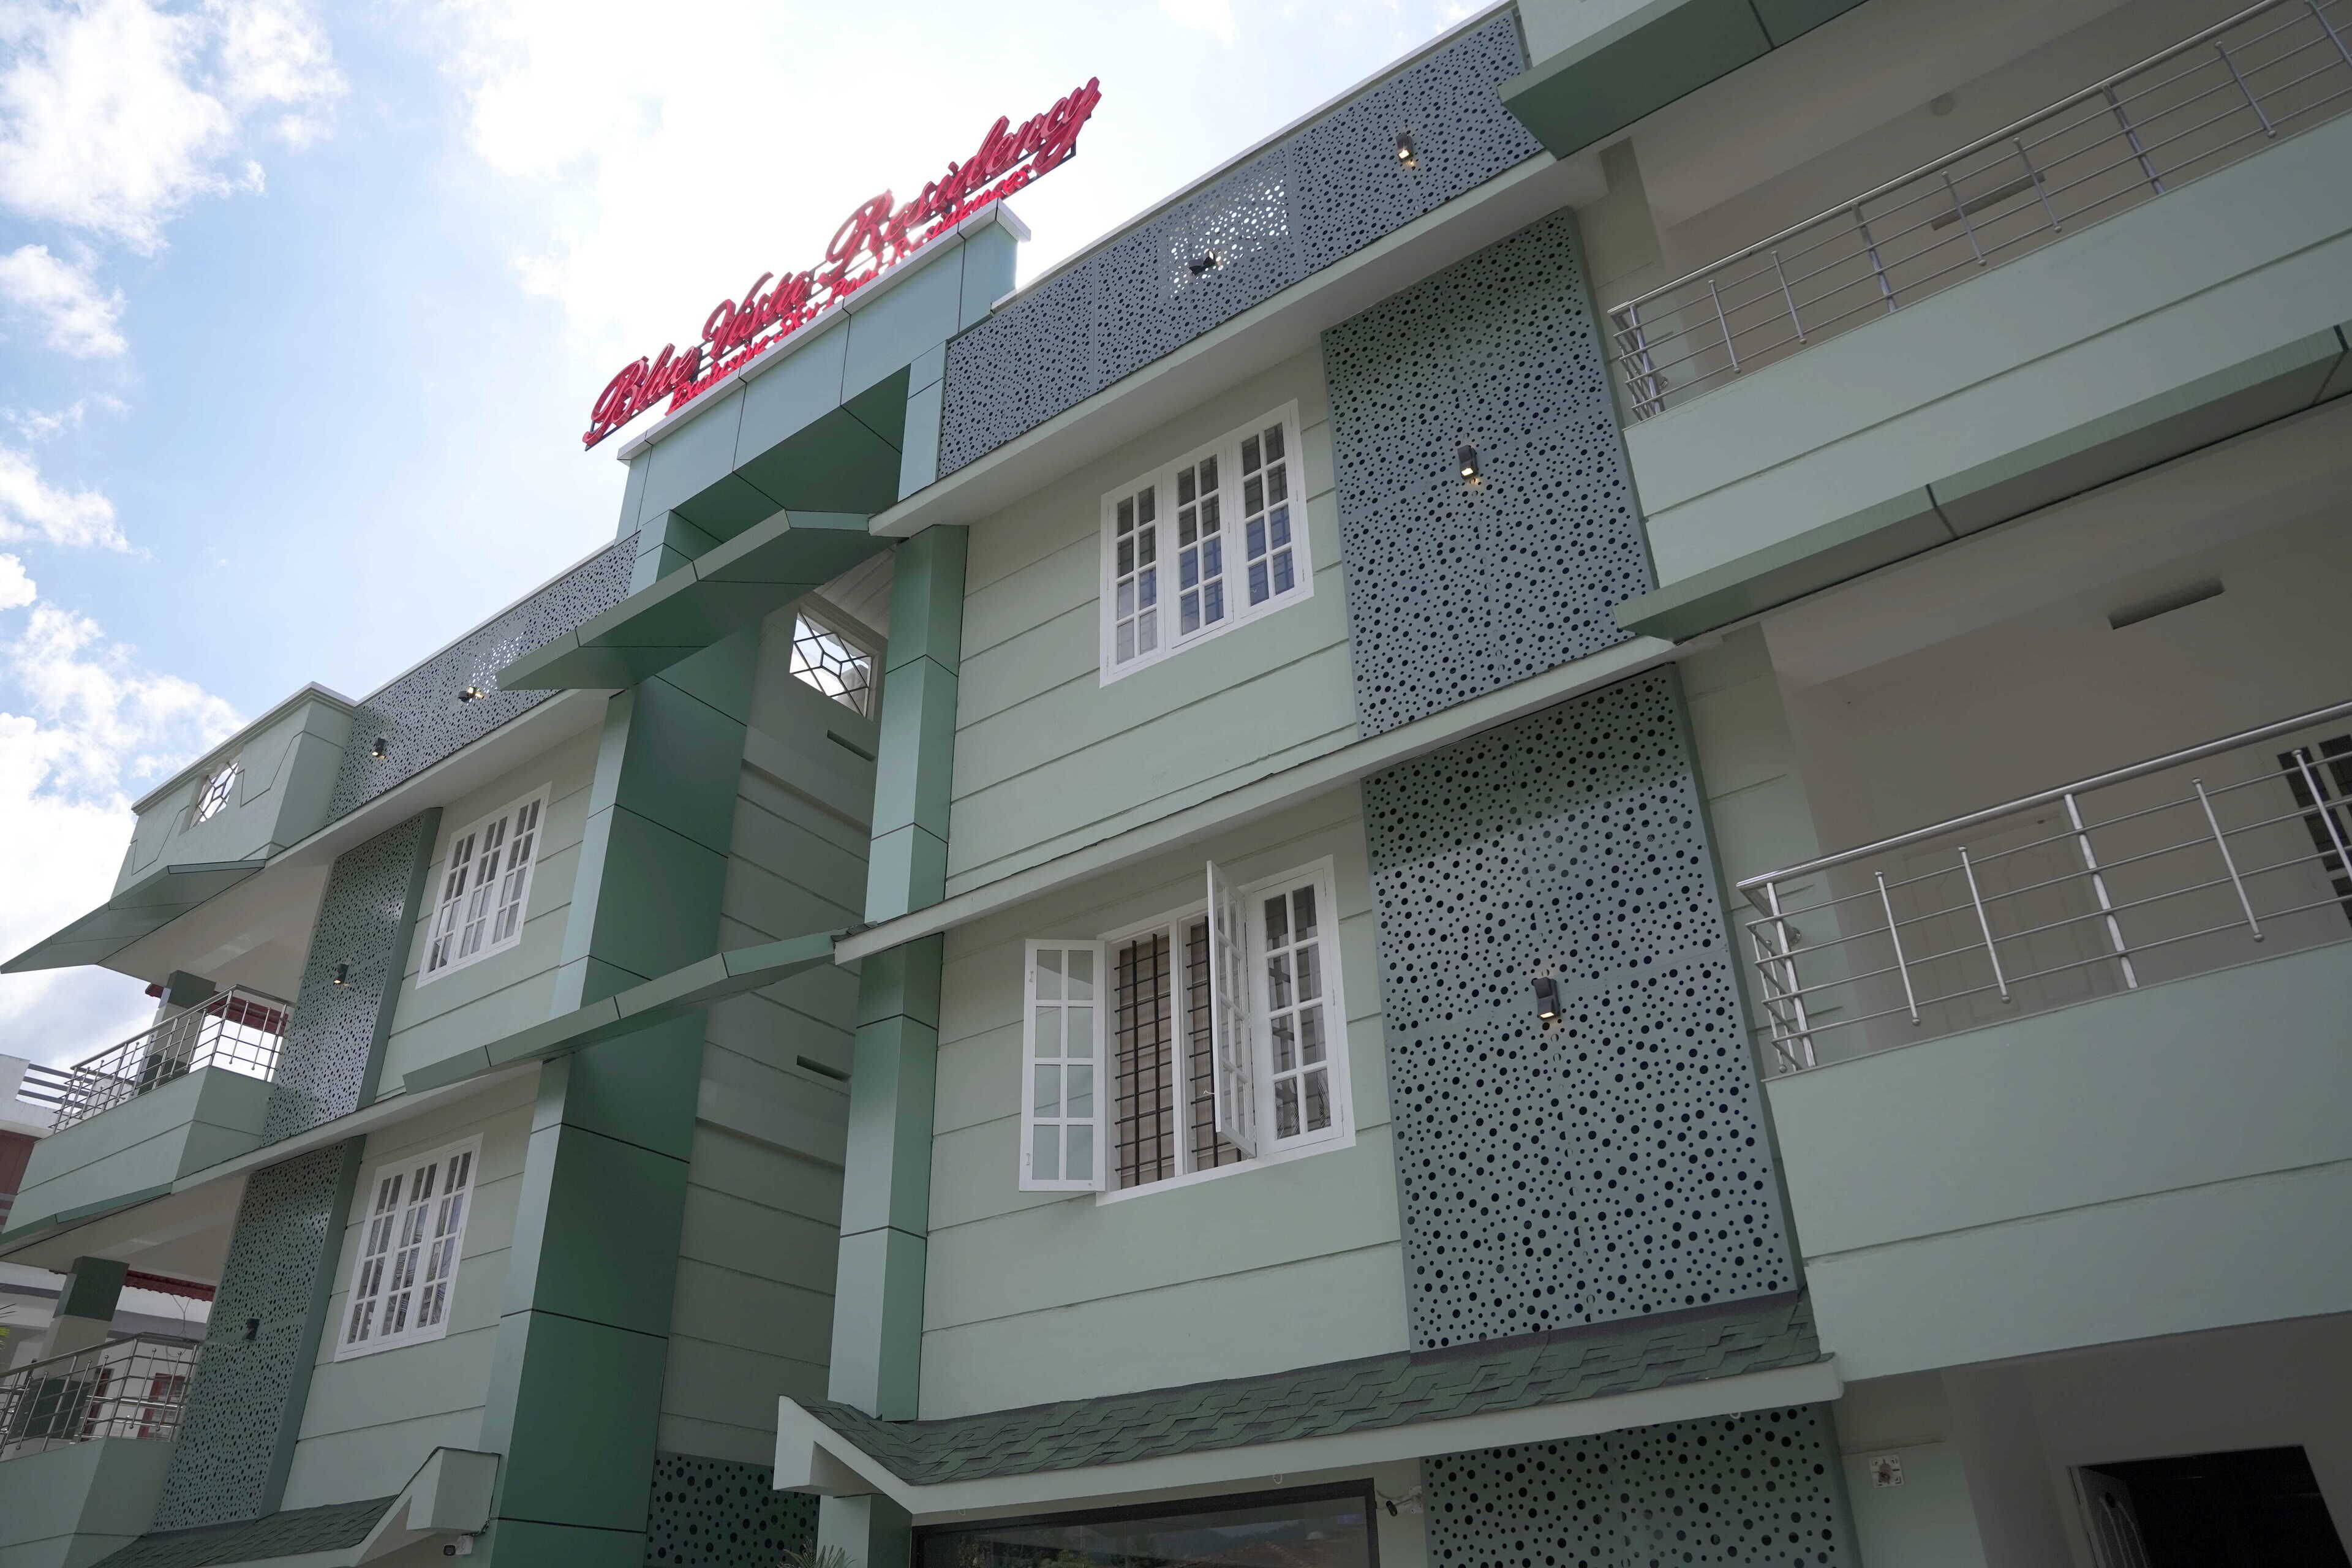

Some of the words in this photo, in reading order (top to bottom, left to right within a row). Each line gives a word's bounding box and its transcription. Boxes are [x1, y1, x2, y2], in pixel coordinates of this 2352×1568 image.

[582, 342, 703, 447] Blue
[701, 271, 813, 361] Vista
[817, 77, 1102, 285] Residency
